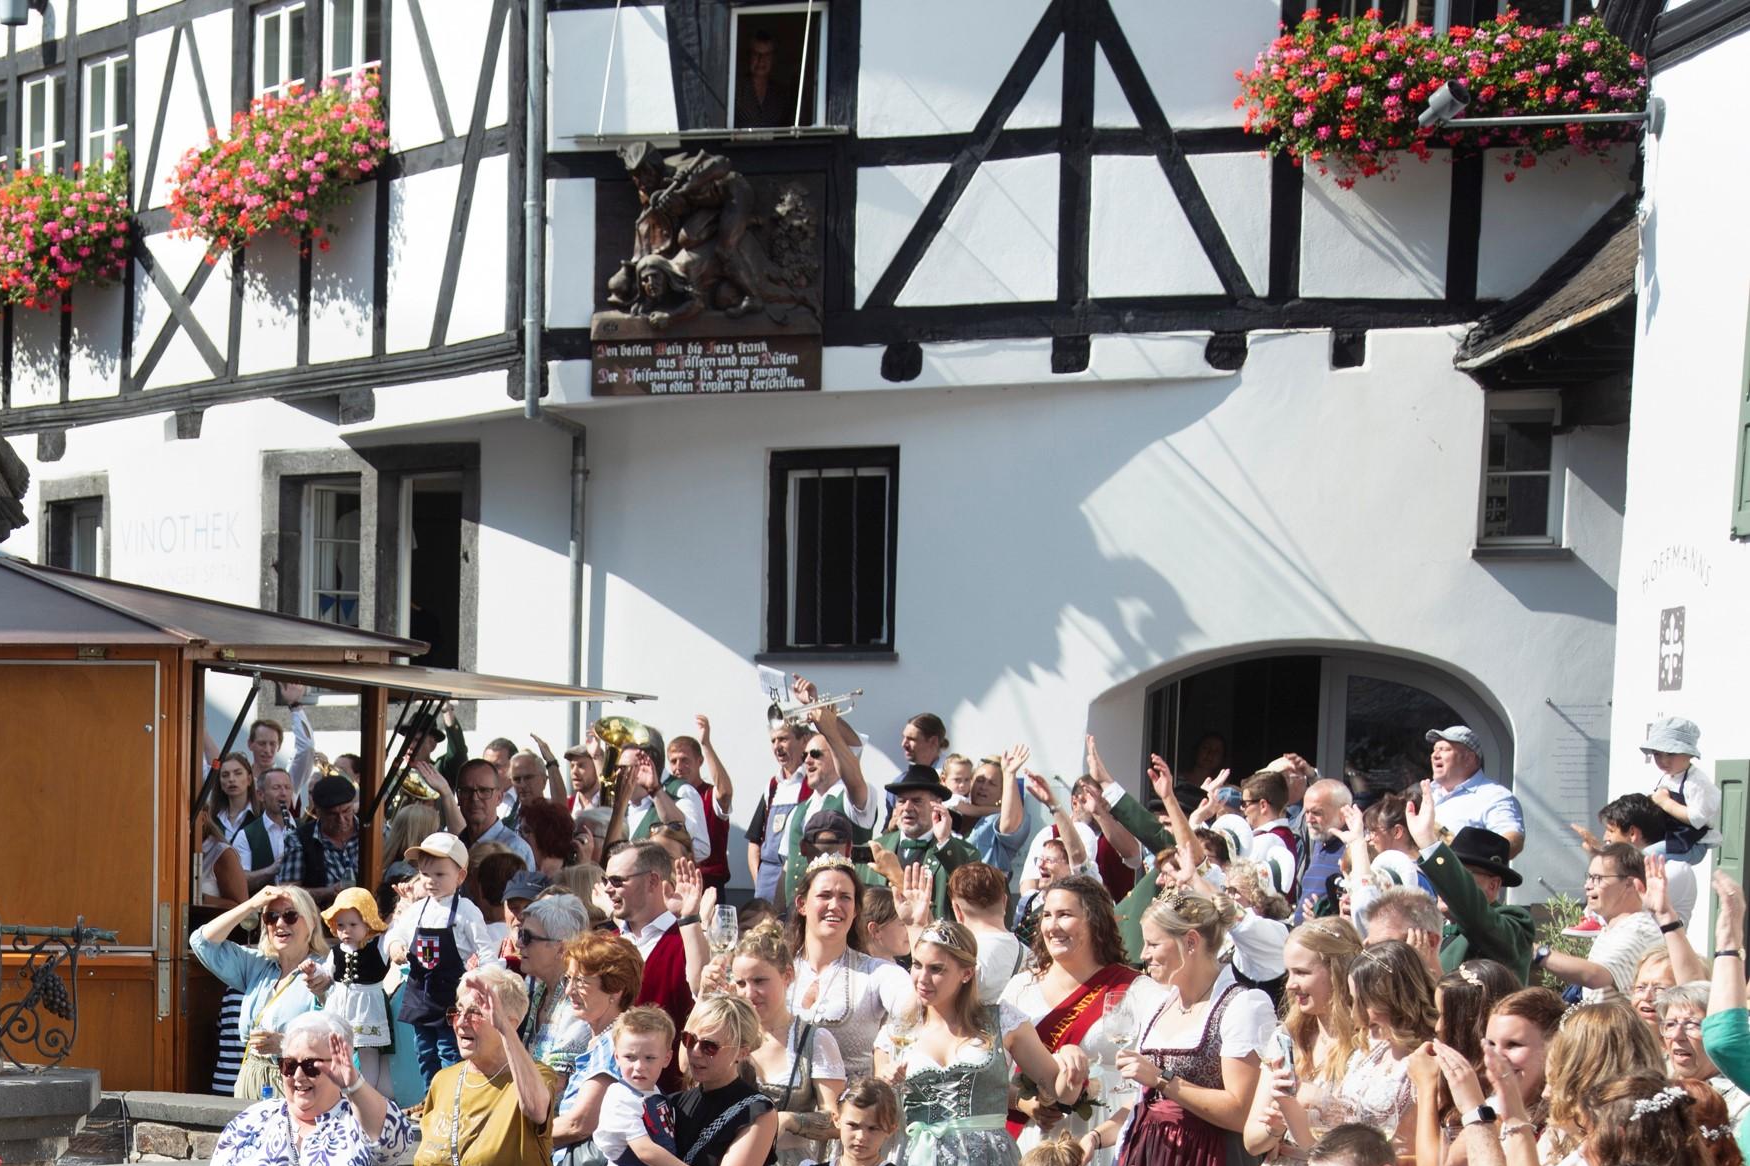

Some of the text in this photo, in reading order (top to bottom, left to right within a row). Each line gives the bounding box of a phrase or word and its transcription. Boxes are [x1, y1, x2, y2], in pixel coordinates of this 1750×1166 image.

[656, 358, 676, 368] aus
[718, 355, 737, 367] und
[740, 356, 759, 366] aus
[687, 341, 703, 354] die
[120, 511, 241, 554] VINOTHEK
[1642, 544, 1713, 596] HOFFMANNS
